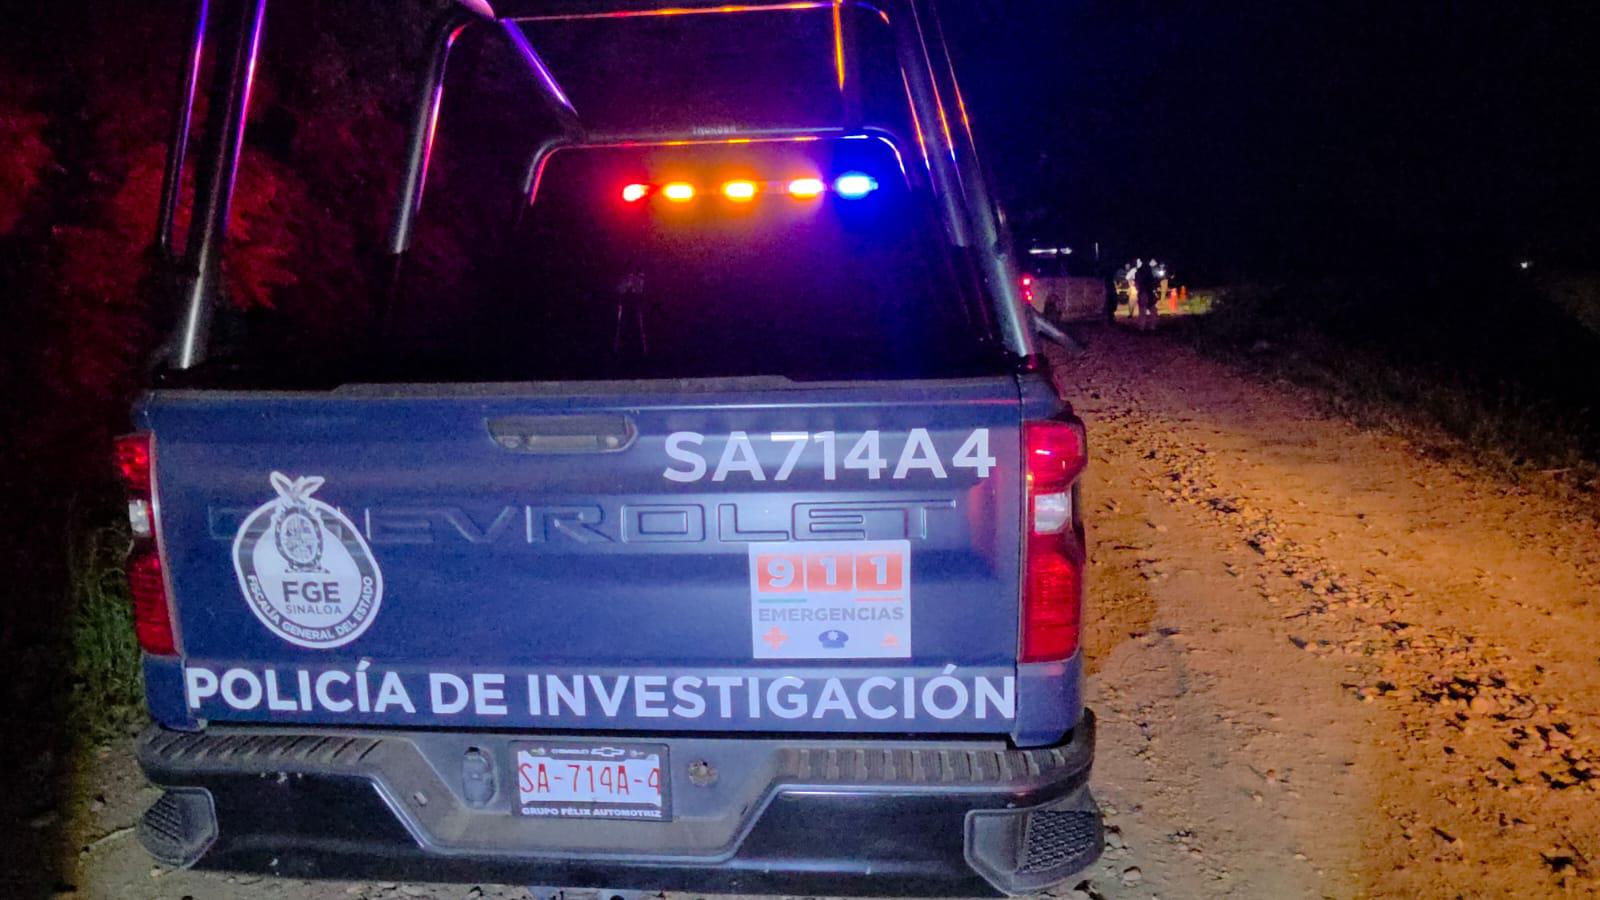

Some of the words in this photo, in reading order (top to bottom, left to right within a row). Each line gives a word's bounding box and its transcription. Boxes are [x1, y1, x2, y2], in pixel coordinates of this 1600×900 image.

[663, 428, 997, 482] SA714A4
[208, 499, 957, 544] CEVROLET
[281, 621, 336, 640] GENERAL
[335, 618, 357, 636] DEL
[352, 576, 374, 622] ESTADO
[282, 581, 341, 604] FGE
[285, 604, 343, 615] SINALOA
[758, 607, 904, 622] EMERGENCIAS
[185, 660, 417, 714] POLICÍA
[429, 672, 508, 716] DE
[527, 664, 1016, 720] INVESTIGACIÓN
[519, 763, 661, 795] SA-714A-4
[521, 807, 559, 816] GRUPO
[593, 808, 662, 818] AUTOMOTRIZ
